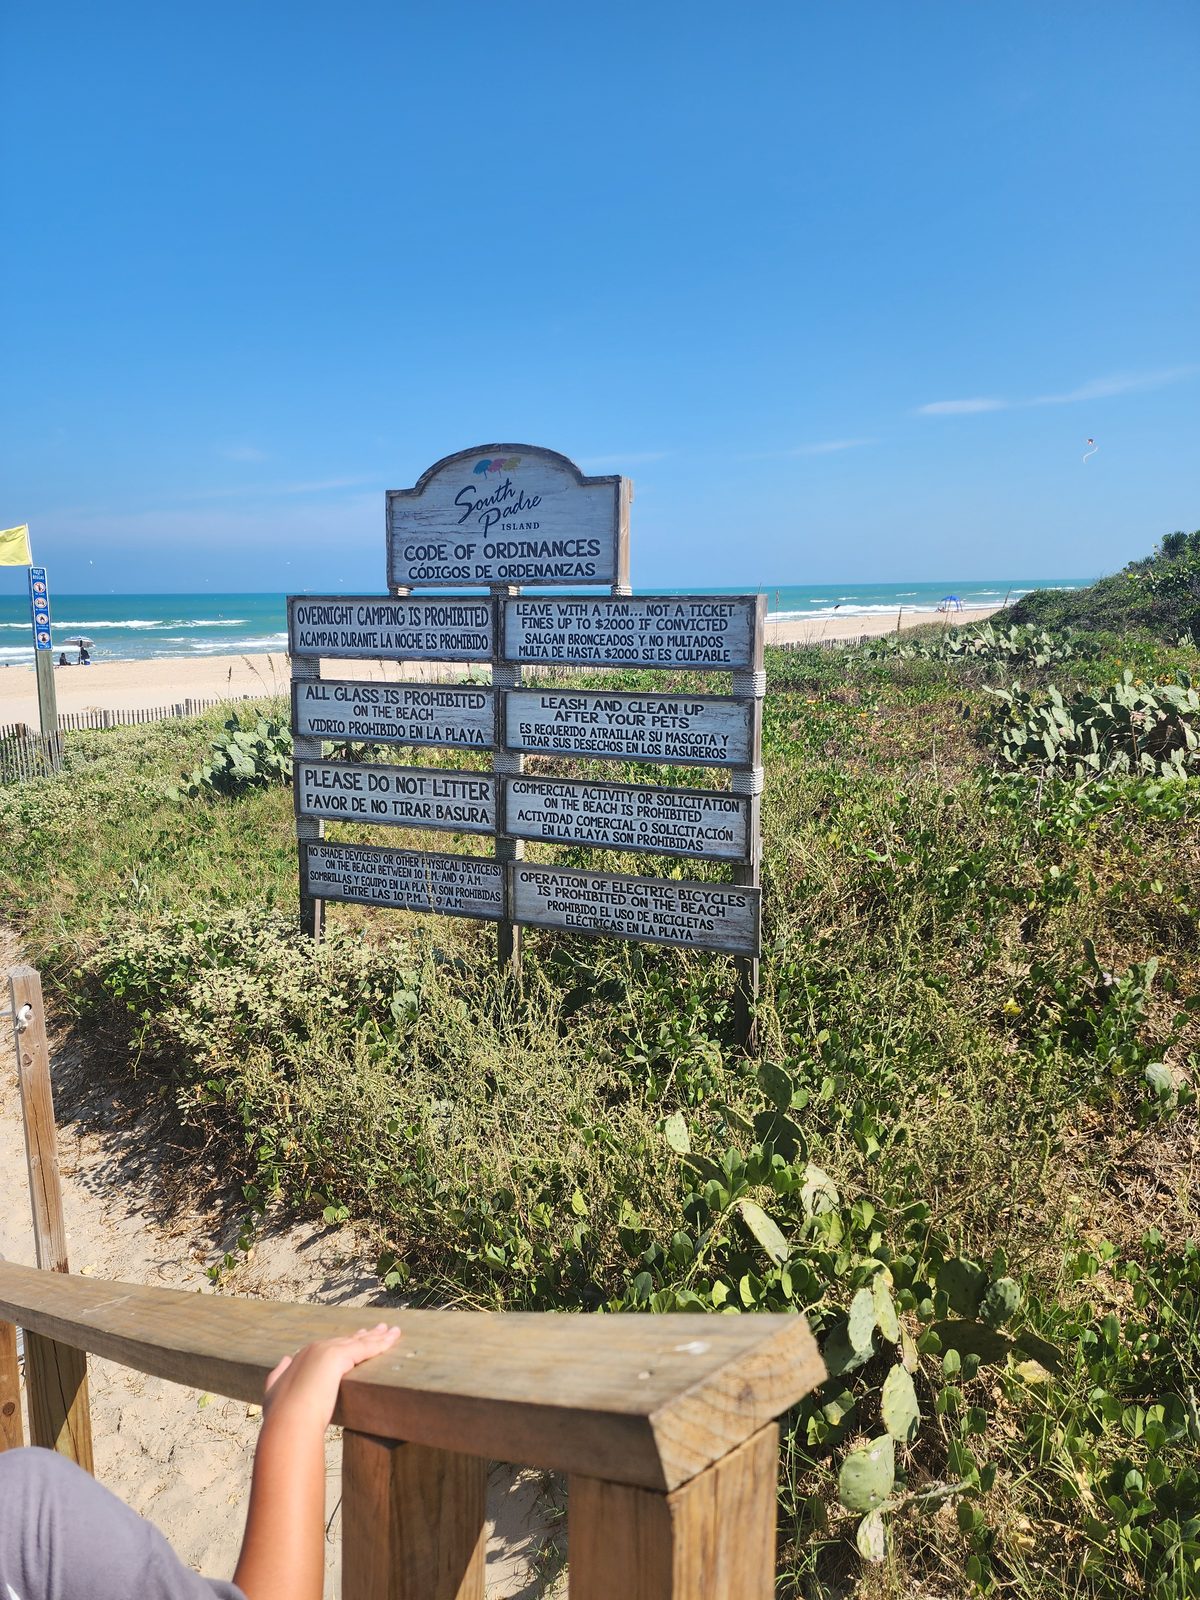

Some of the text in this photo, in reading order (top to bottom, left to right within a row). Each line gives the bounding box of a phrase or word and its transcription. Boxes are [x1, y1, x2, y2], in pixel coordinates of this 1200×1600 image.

[454, 478, 516, 524] South
[478, 490, 542, 538] Padre
[502, 522, 540, 530] ISLAND
[404, 539, 600, 562] CODE OF ORDINANCES
[408, 562, 595, 580] CÓDIGOS DE ORDENANZAS
[297, 606, 488, 627] OVERNIGHT CAMPING IS PROHIBITED
[516, 604, 735, 617] LEAVE WITH A TAN... NOT A TICKET
[522, 618, 728, 631] FINES UP TO $2000 IF CONVICTED
[300, 632, 488, 650] ACAMPAR DURANTE LA NOCHE ES PROHIBIDO
[525, 633, 723, 648] SALGAN BRONCEADOS Y NO MULTADOS
[519, 646, 730, 662] MULTA DE HASTA $2000 SI ES CULPABLE
[306, 686, 485, 709] ALL GLASS IS PROHIBITED
[541, 697, 704, 716] LEASH AND CLEAN UP
[354, 705, 434, 720] ON THE BEACH
[554, 710, 690, 728] AFTER YOUR PETS
[309, 719, 484, 743] VIDRIO PROHIBIDO EN LA PLAYA
[520, 723, 729, 746] ES REQUERIDO ATRAILLAR SU MASCOTA Y
[522, 735, 727, 759] TIRAR SUS DESECHOS EN LOS BASUREROS
[305, 770, 490, 801] PLEASE DO NOT LITTER
[513, 782, 740, 812] COMMERCIAL ACTIVITY OR SOLICITATION
[306, 794, 490, 824] FAVOR DE NO TIRAR BASURA
[544, 798, 702, 822] ON THE BEACH IS PROHIBITED
[518, 810, 734, 841] ACTIVIDAD COMERCIAL O SOLICITACIÓN
[542, 824, 703, 851] EN LA PLAYA SON PROHIBIDAS
[309, 847, 318, 856] NO
[320, 849, 344, 860] SHADE
[345, 851, 381, 863] DEVICE(S)
[383, 855, 394, 864] OR
[396, 856, 419, 867] OTHER
[462, 863, 501, 876] DEVICE(S)
[325, 860, 336, 869] ON
[337, 861, 350, 871] THE
[352, 863, 377, 874] BEACH
[378, 865, 412, 878] BETWEEN
[414, 869, 423, 879] 10
[440, 872, 456, 883] AND
[459, 874, 465, 883] 9
[467, 875, 482, 886] A.M.
[310, 871, 501, 902] SOMBRILLAS Y EQUIPO EN LA PLAYA SON PROHIBIDAS
[343, 886, 464, 908] ENTRE LAS 10 P.M. Y 9 A.M.
[520, 872, 746, 908] OPERATION OF ELECTRIC BICYCLES
[537, 885, 726, 917] IS PROHIBITED ON THE BEACH
[547, 901, 714, 931] PROHIBIDO EL USO DE BICICLETAS
[566, 913, 693, 941] ELÉCTRICAS EN LA PLAYA
